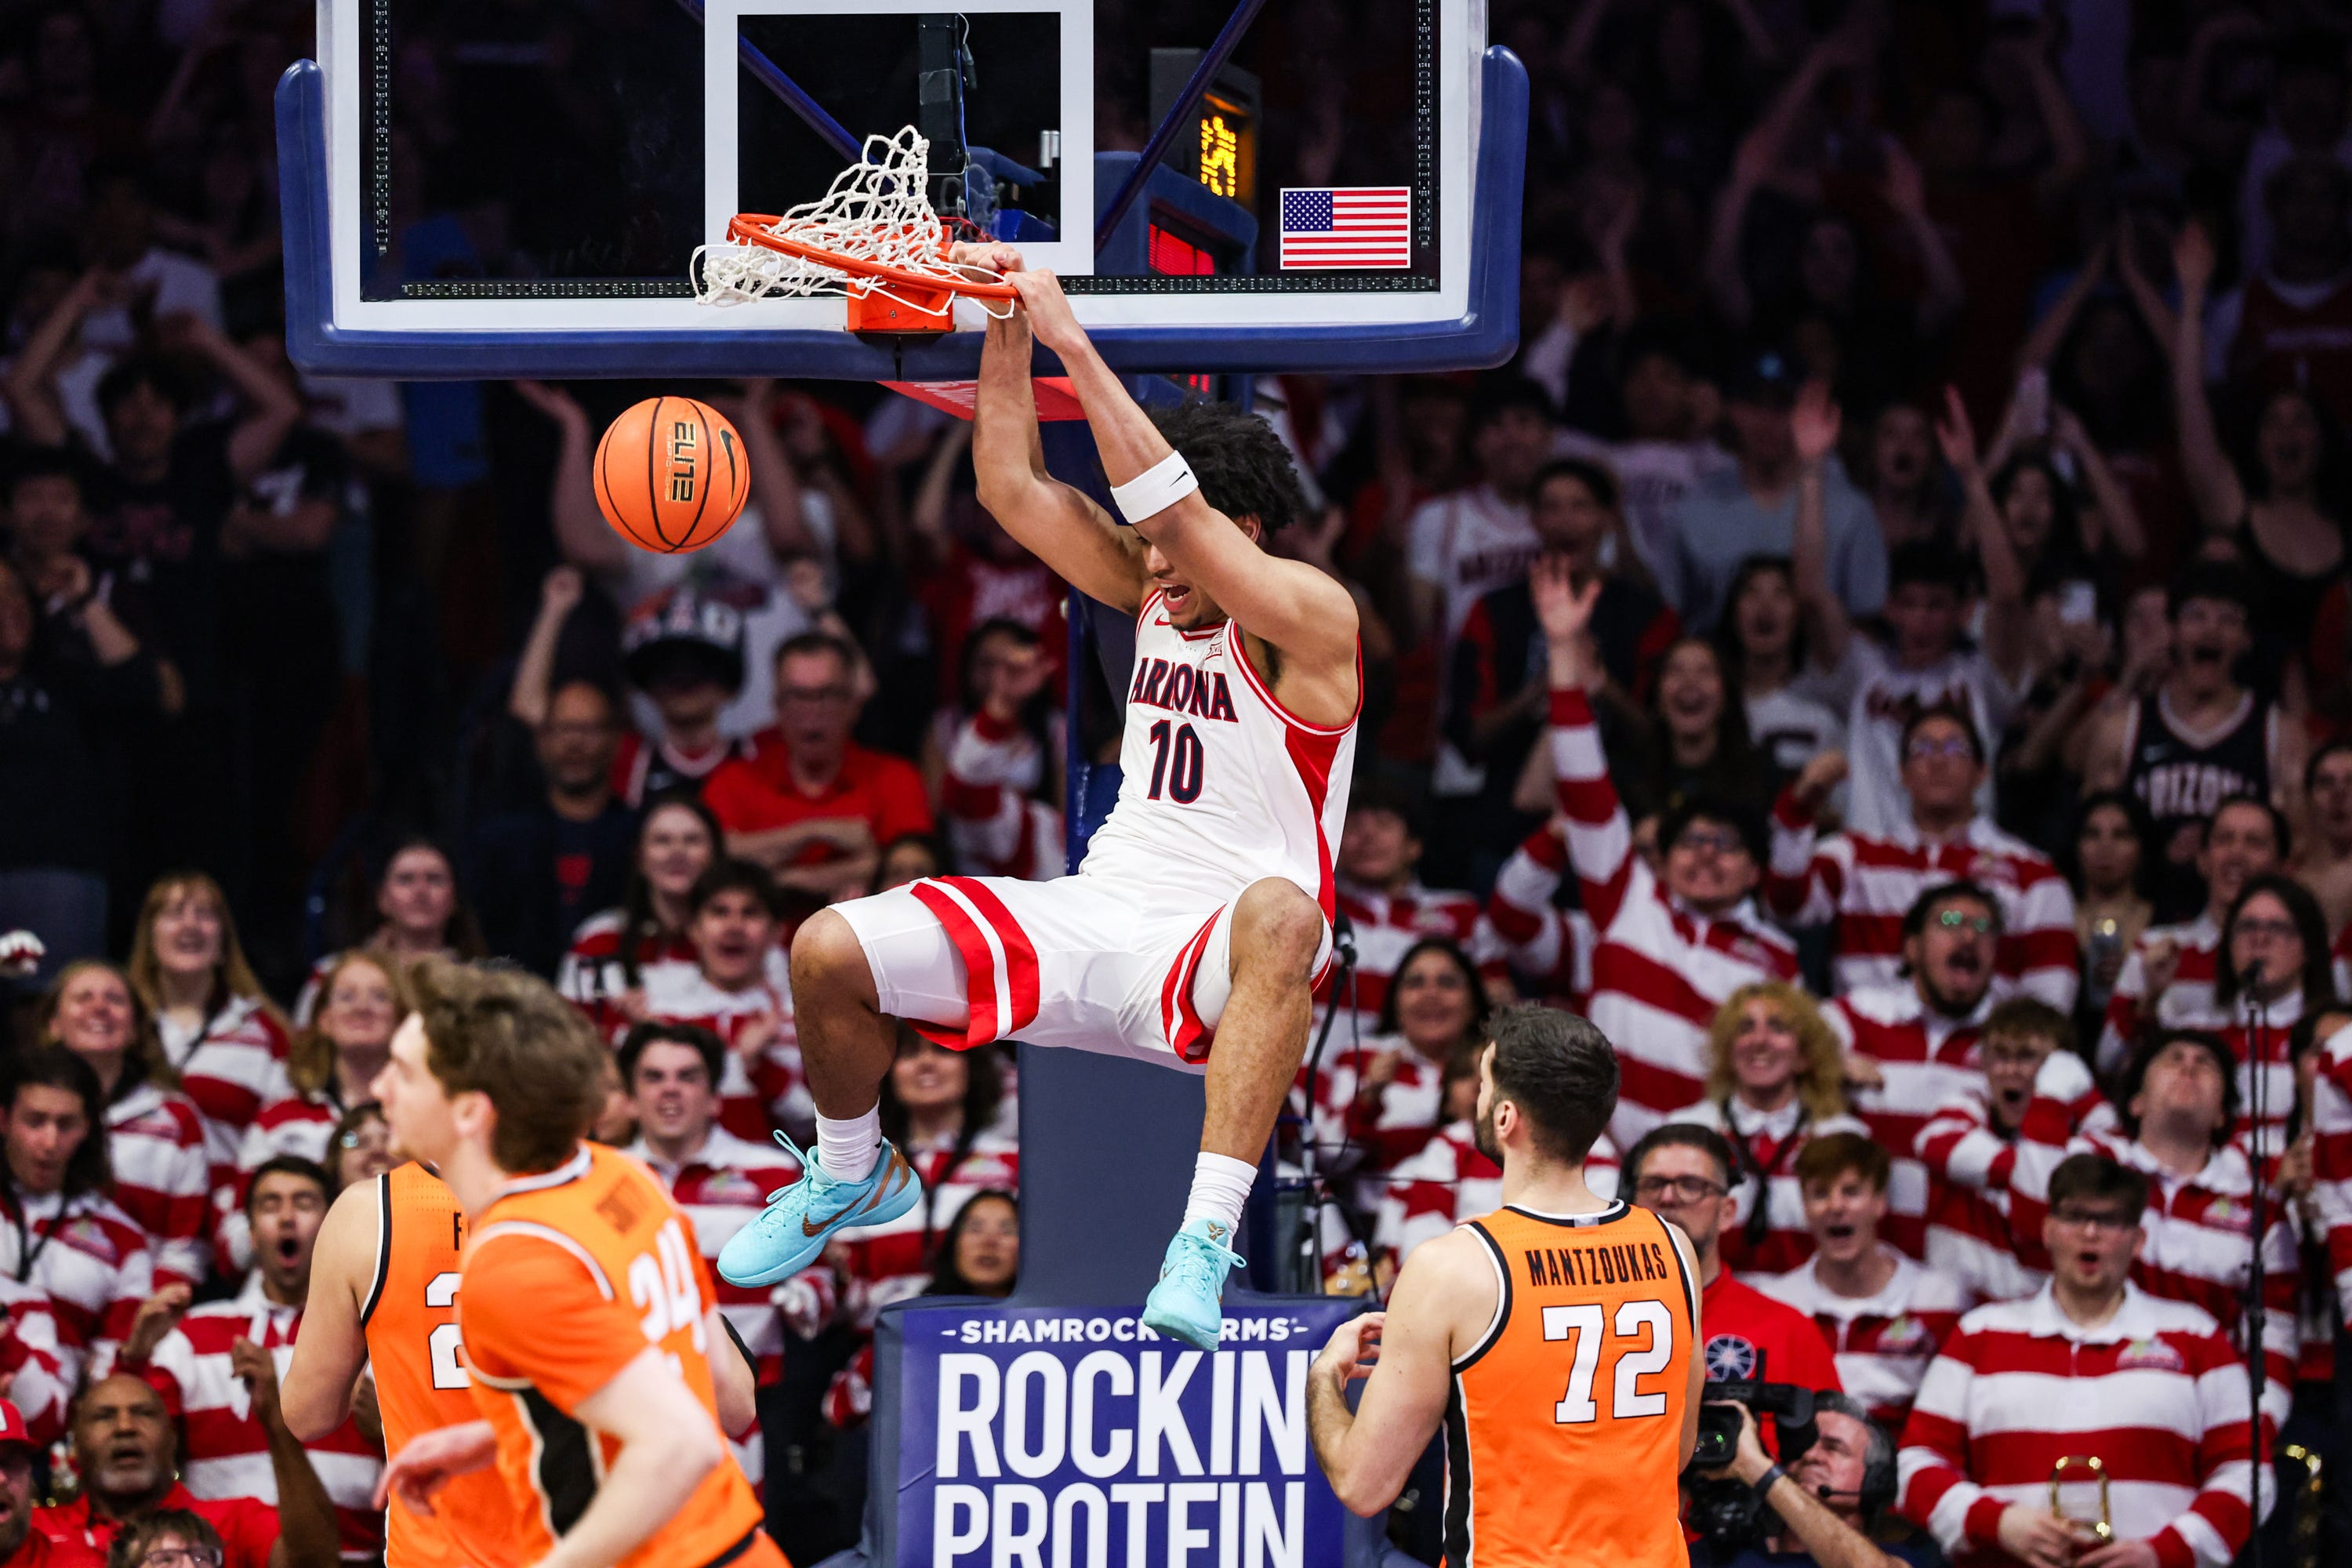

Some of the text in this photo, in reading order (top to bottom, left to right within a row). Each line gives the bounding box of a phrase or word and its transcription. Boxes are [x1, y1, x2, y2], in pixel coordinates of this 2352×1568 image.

[670, 421, 696, 503] ELITE
[1129, 657, 1239, 723] ARIONA
[1147, 719, 1204, 804] 10
[2133, 760, 2258, 820] RIZO
[1525, 1243, 1668, 1287] MANTZOUKAS
[1172, 1317, 1290, 1342] RMS
[1541, 1299, 1673, 1424] 72
